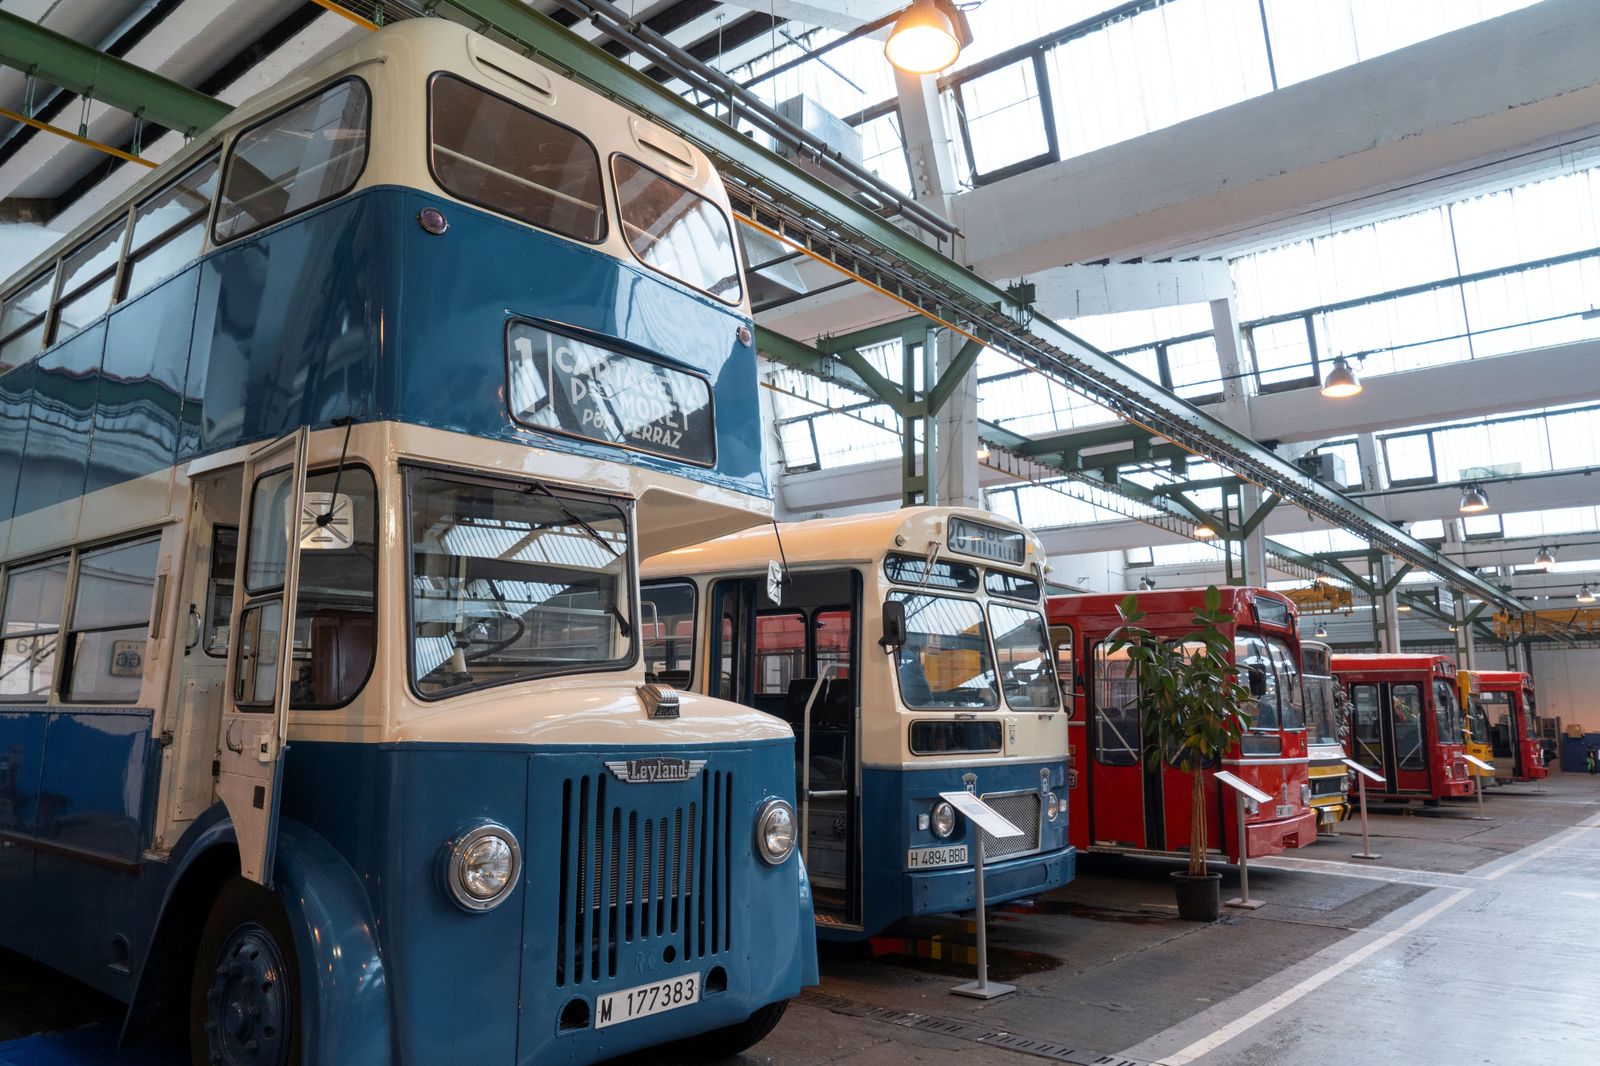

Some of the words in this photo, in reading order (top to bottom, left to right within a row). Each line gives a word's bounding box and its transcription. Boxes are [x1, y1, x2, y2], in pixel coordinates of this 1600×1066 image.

[513, 336, 537, 413] 1
[555, 346, 704, 406] CARTAGENA
[621, 394, 690, 431] MORET
[623, 418, 683, 449] FERRAZ
[950, 522, 966, 549] 20
[978, 527, 1003, 542] SOL
[630, 760, 687, 782] Leyland
[909, 851, 919, 866] H
[921, 849, 948, 866] 4894
[948, 847, 966, 864] BBD
[600, 997, 613, 1024] M
[627, 979, 695, 1017] 177383
